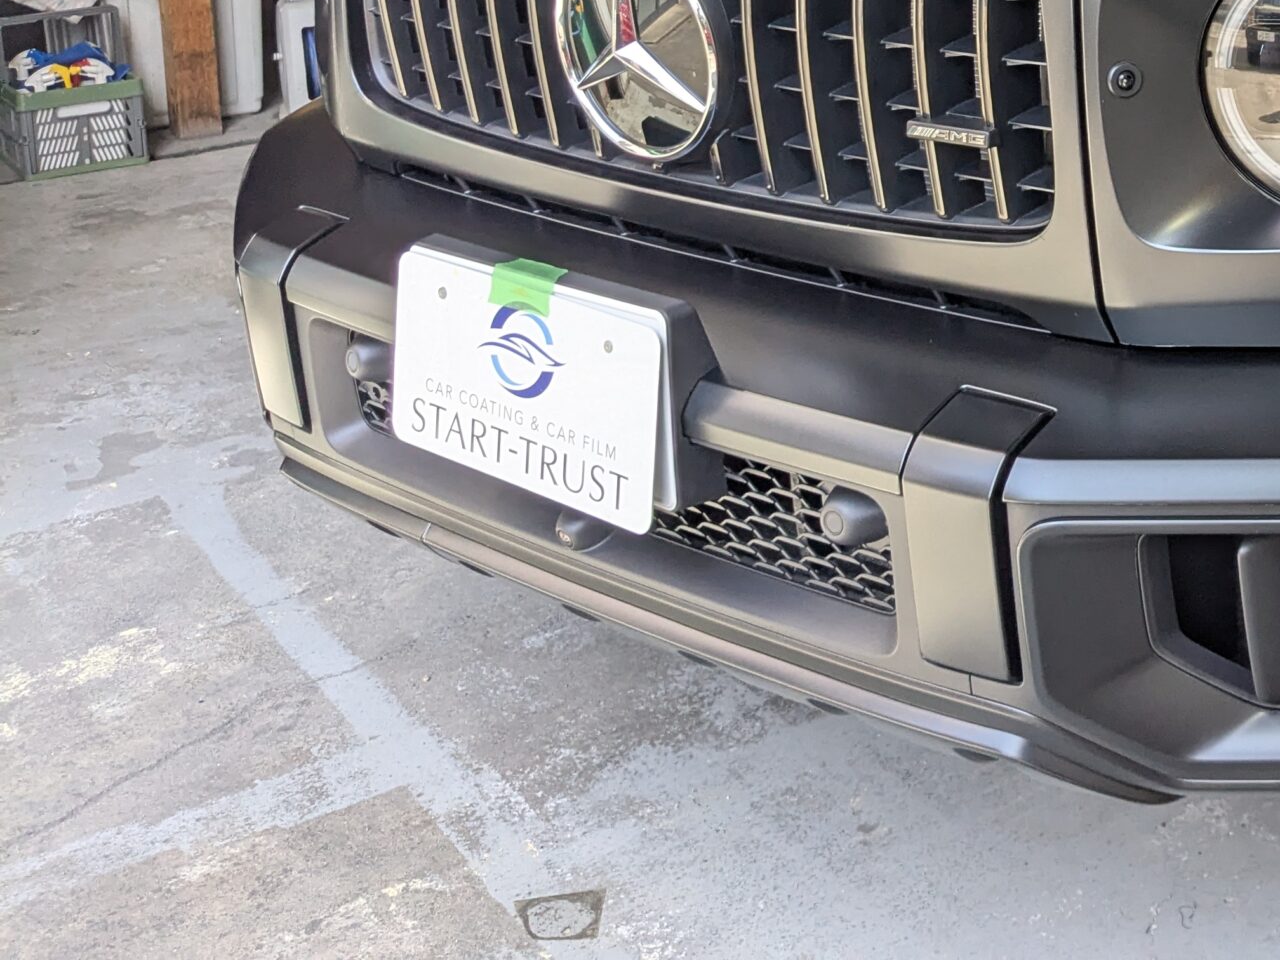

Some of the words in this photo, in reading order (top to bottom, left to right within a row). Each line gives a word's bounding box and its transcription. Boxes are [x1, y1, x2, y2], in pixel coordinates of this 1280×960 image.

[411, 396, 629, 511] START-TRUST
[425, 377, 453, 401] CAR
[458, 389, 524, 426] COATING
[530, 415, 540, 433] &
[546, 421, 577, 445] CAR
[582, 434, 617, 462] FILM
